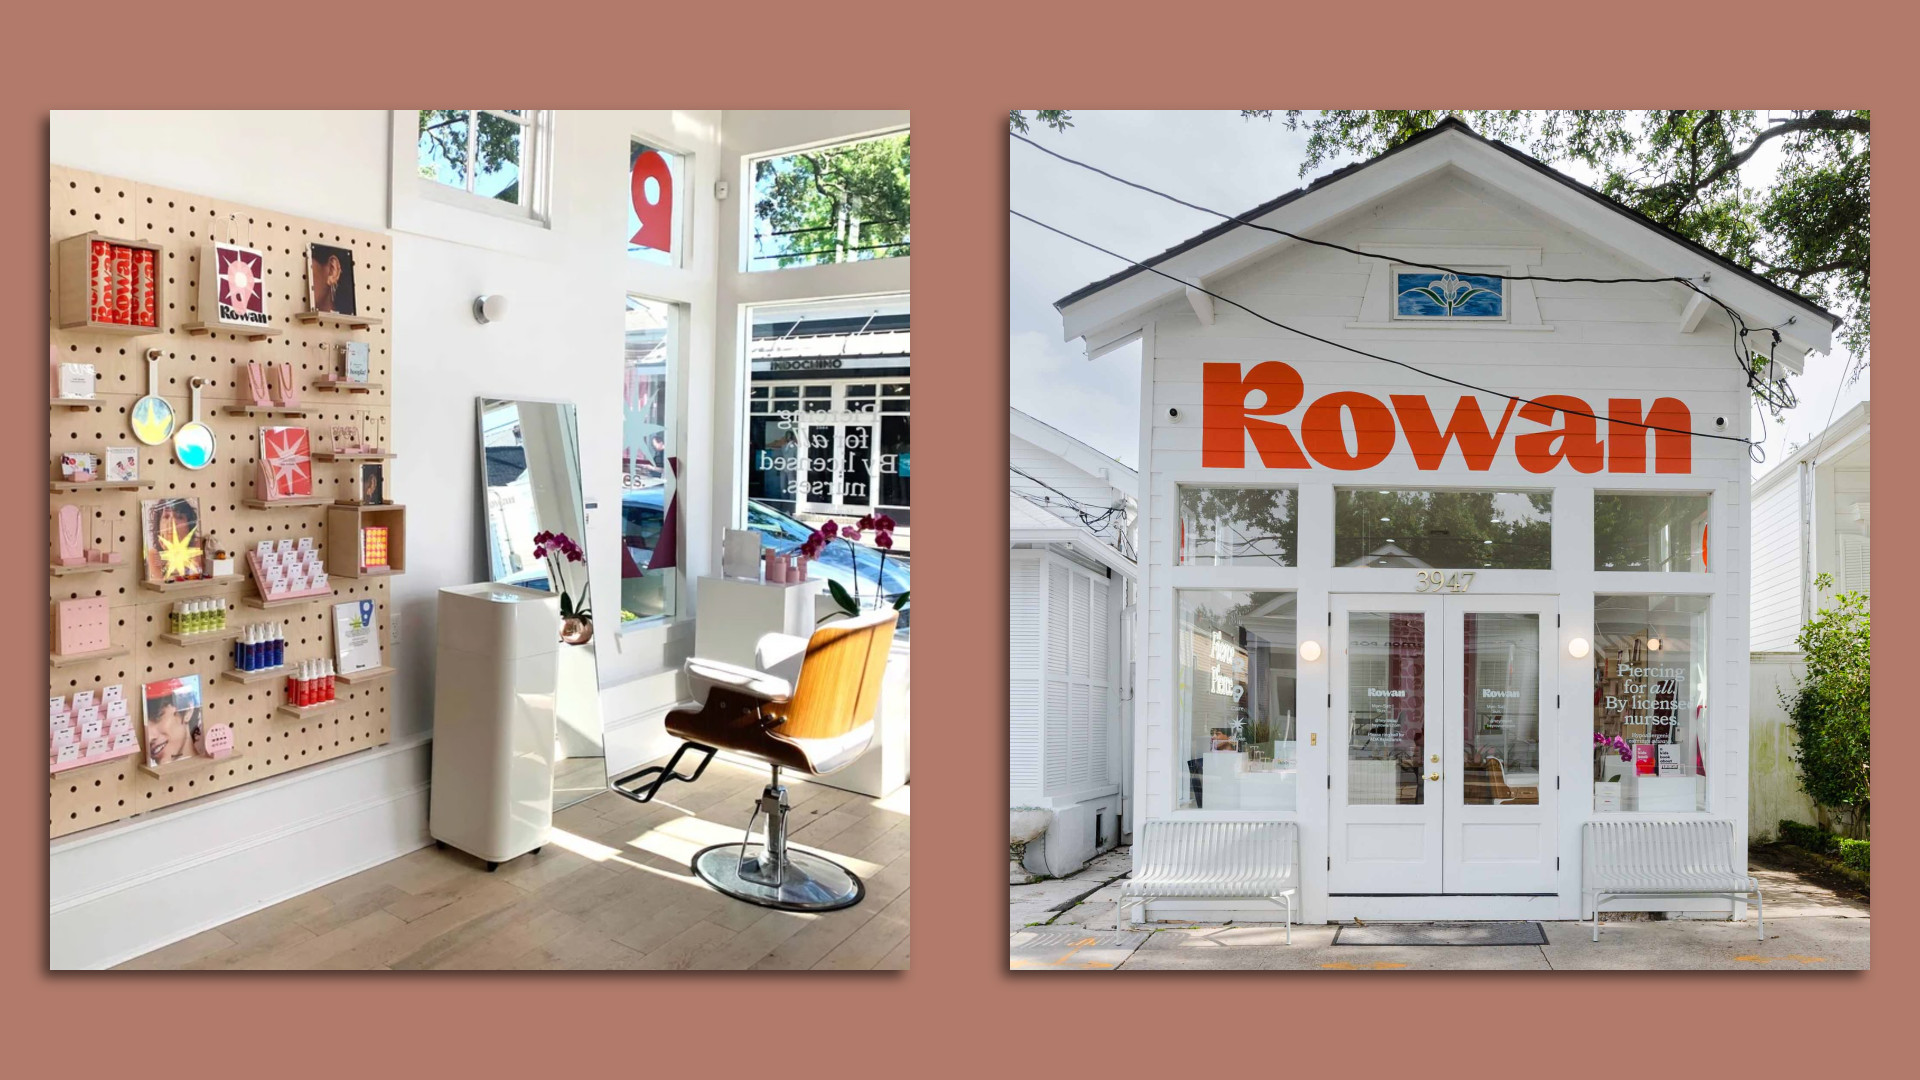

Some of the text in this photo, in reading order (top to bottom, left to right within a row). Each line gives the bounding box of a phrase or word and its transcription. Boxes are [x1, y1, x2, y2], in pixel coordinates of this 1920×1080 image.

[113, 247, 130, 324] Rowan
[220, 305, 267, 324] Rowan
[771, 359, 842, 371] INDOCHINO
[1202, 361, 1691, 474] Rowan
[1416, 571, 1476, 593] 3947
[1617, 663, 1685, 681] Piercing
[1367, 688, 1405, 697] Rowan
[1482, 689, 1520, 698] Rowan
[1624, 679, 1676, 694] for all.
[1605, 696, 1627, 712] By
[1624, 714, 1680, 726] nurses.
